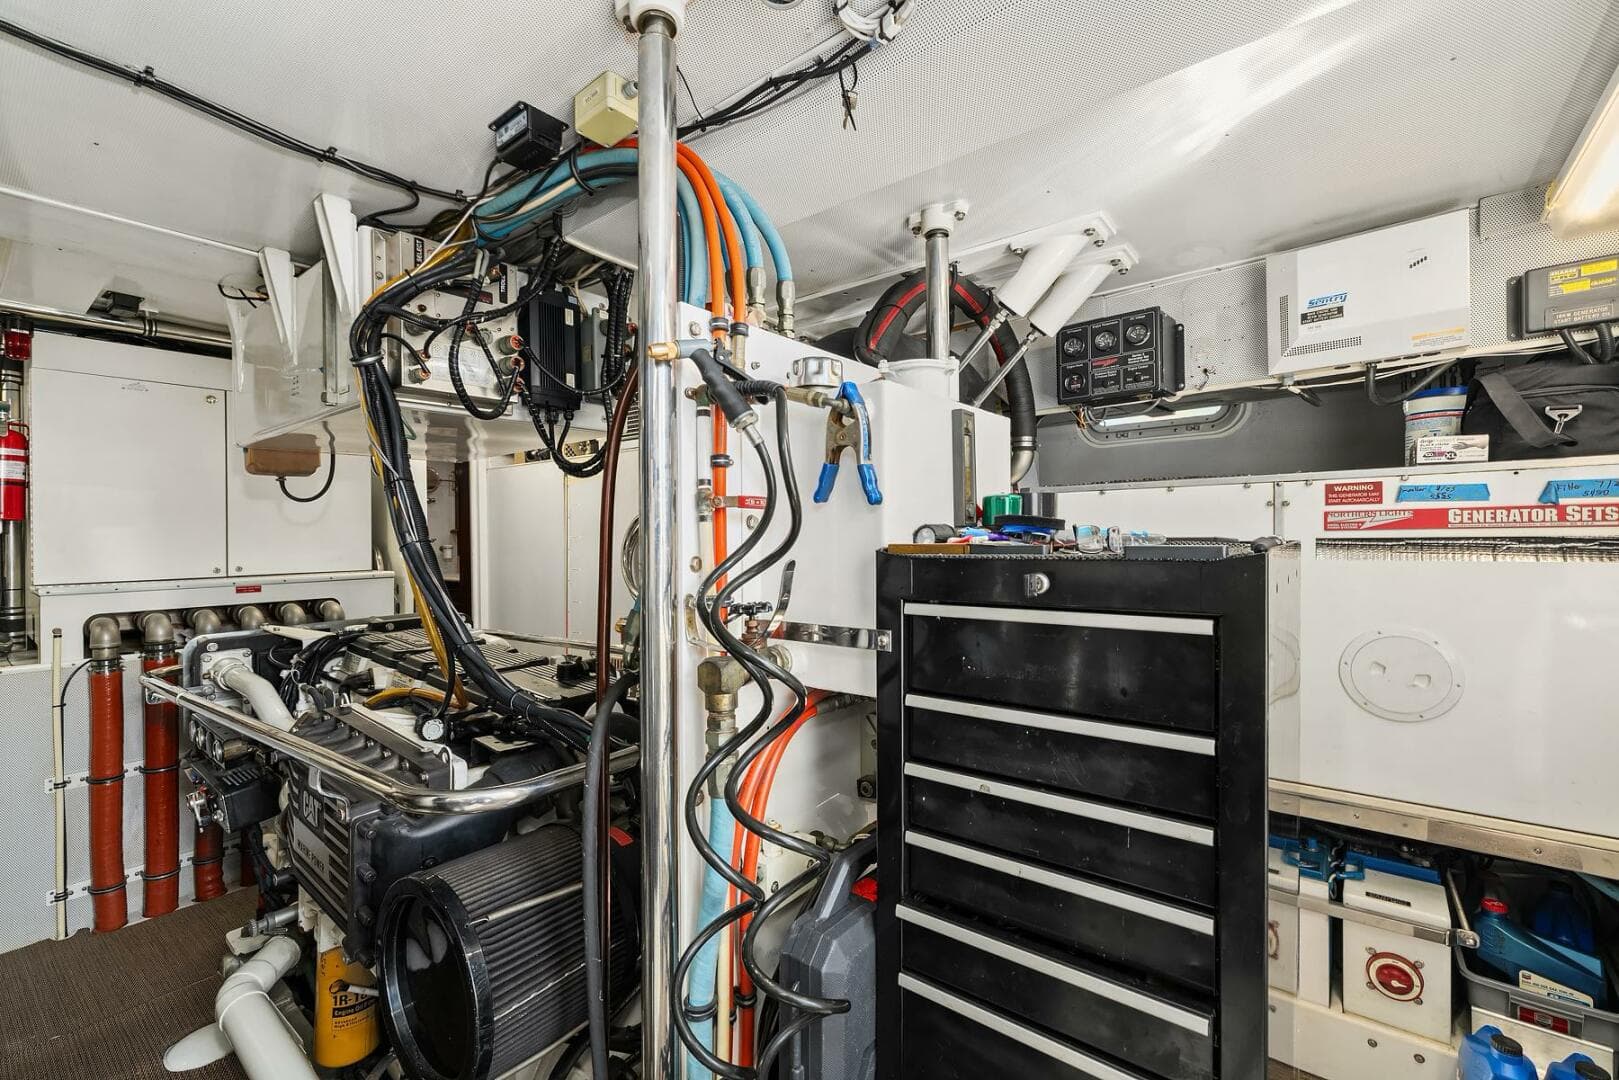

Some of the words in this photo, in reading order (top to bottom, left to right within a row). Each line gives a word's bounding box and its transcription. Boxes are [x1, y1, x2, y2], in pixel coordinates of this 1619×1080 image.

[1307, 292, 1348, 309] Sentry
[1333, 484, 1374, 492] WARNING
[1447, 507, 1558, 524] GENERATOR
[1565, 505, 1619, 522] SETS
[303, 790, 321, 828] CAT
